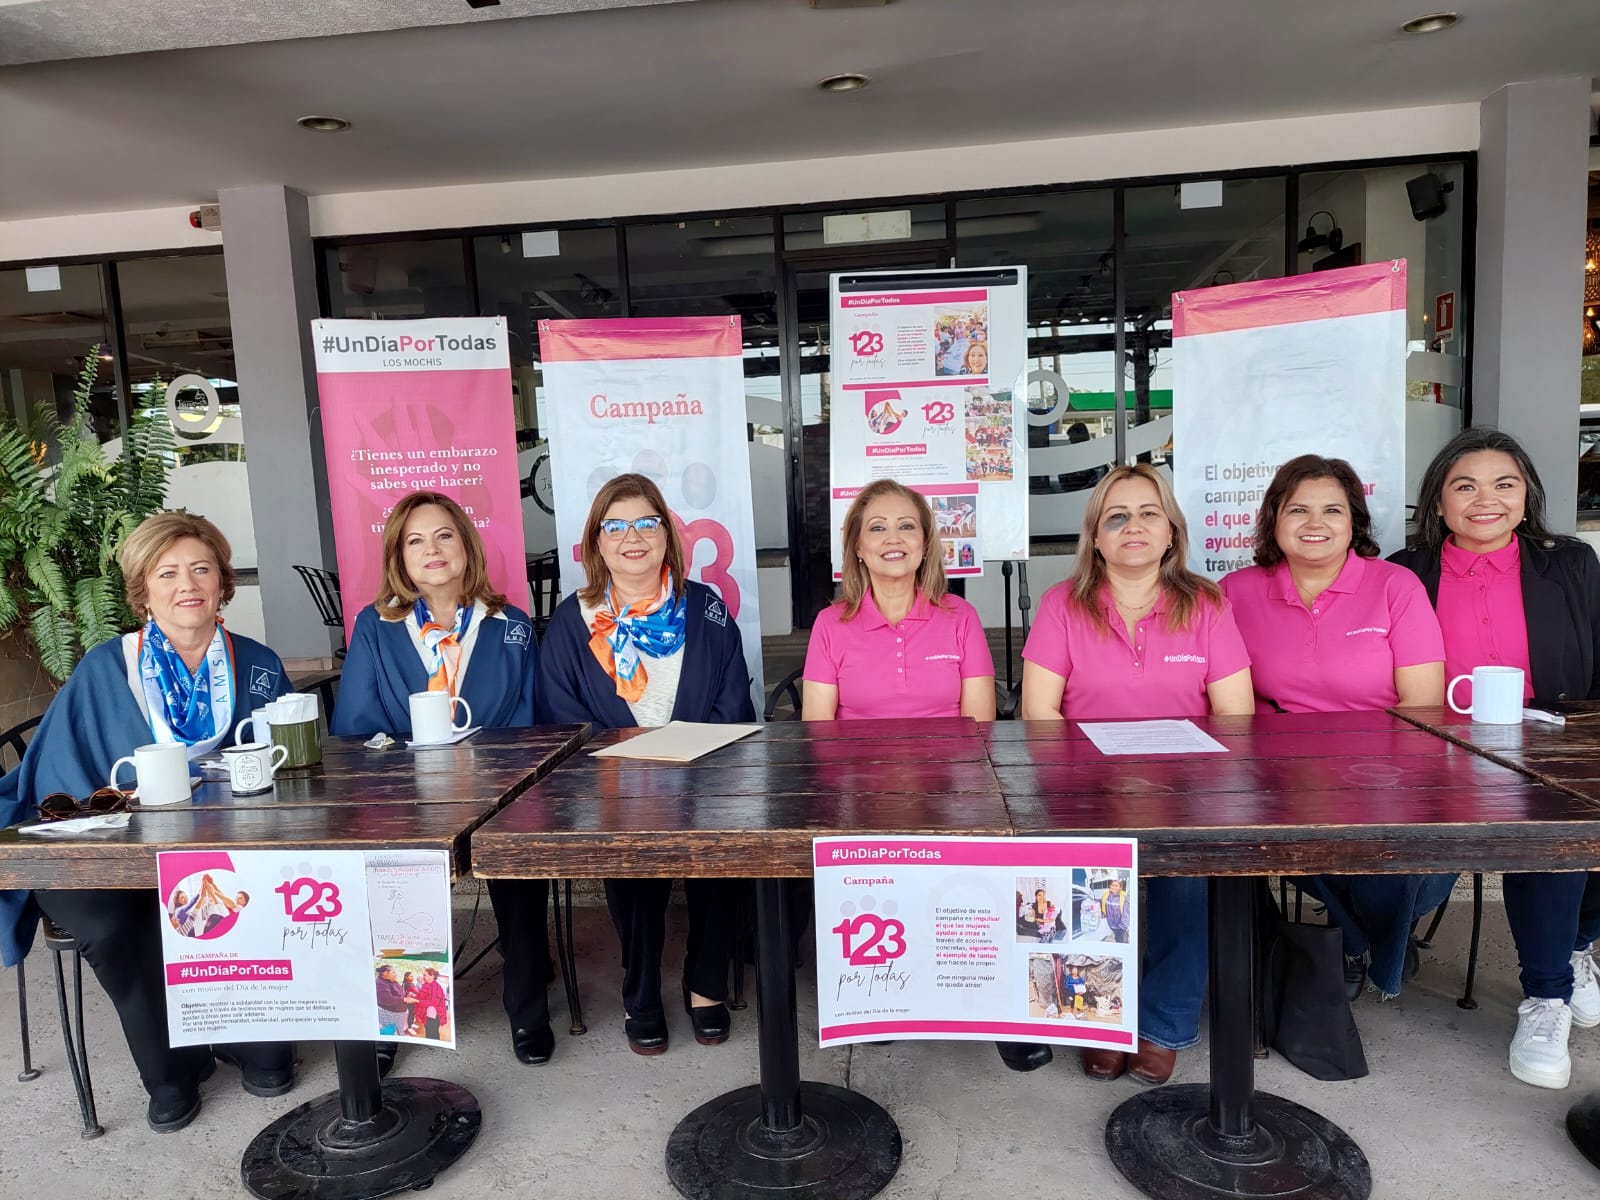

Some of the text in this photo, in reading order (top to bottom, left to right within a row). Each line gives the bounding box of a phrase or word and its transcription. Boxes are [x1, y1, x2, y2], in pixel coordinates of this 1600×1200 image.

[323, 334, 497, 353] #UnDíaPorTodas
[848, 331, 884, 356] 123
[383, 357, 442, 367] LOS MOCHIS
[590, 393, 703, 424] Campaña
[921, 401, 955, 424] 123
[351, 447, 497, 461] ¿Tienes un embarazo
[370, 461, 481, 477] inesperado y no
[1205, 464, 1218, 480] El
[370, 475, 483, 490] sabes qué hacer?
[1205, 485, 1265, 506] campañ
[1205, 511, 1218, 527] el
[1223, 513, 1250, 530] que
[832, 848, 942, 859] #UnDíaPorTodas
[843, 876, 894, 887] Campaña
[274, 877, 343, 922] 123
[943, 907, 967, 915] objetivo
[283, 925, 307, 951] por
[832, 914, 907, 966] 123
[196, 951, 228, 960] CAMPAÑA
[180, 964, 289, 978] #UnDíaPorTodas
[268, 984, 288, 992] mujer
[837, 968, 865, 1002] por
